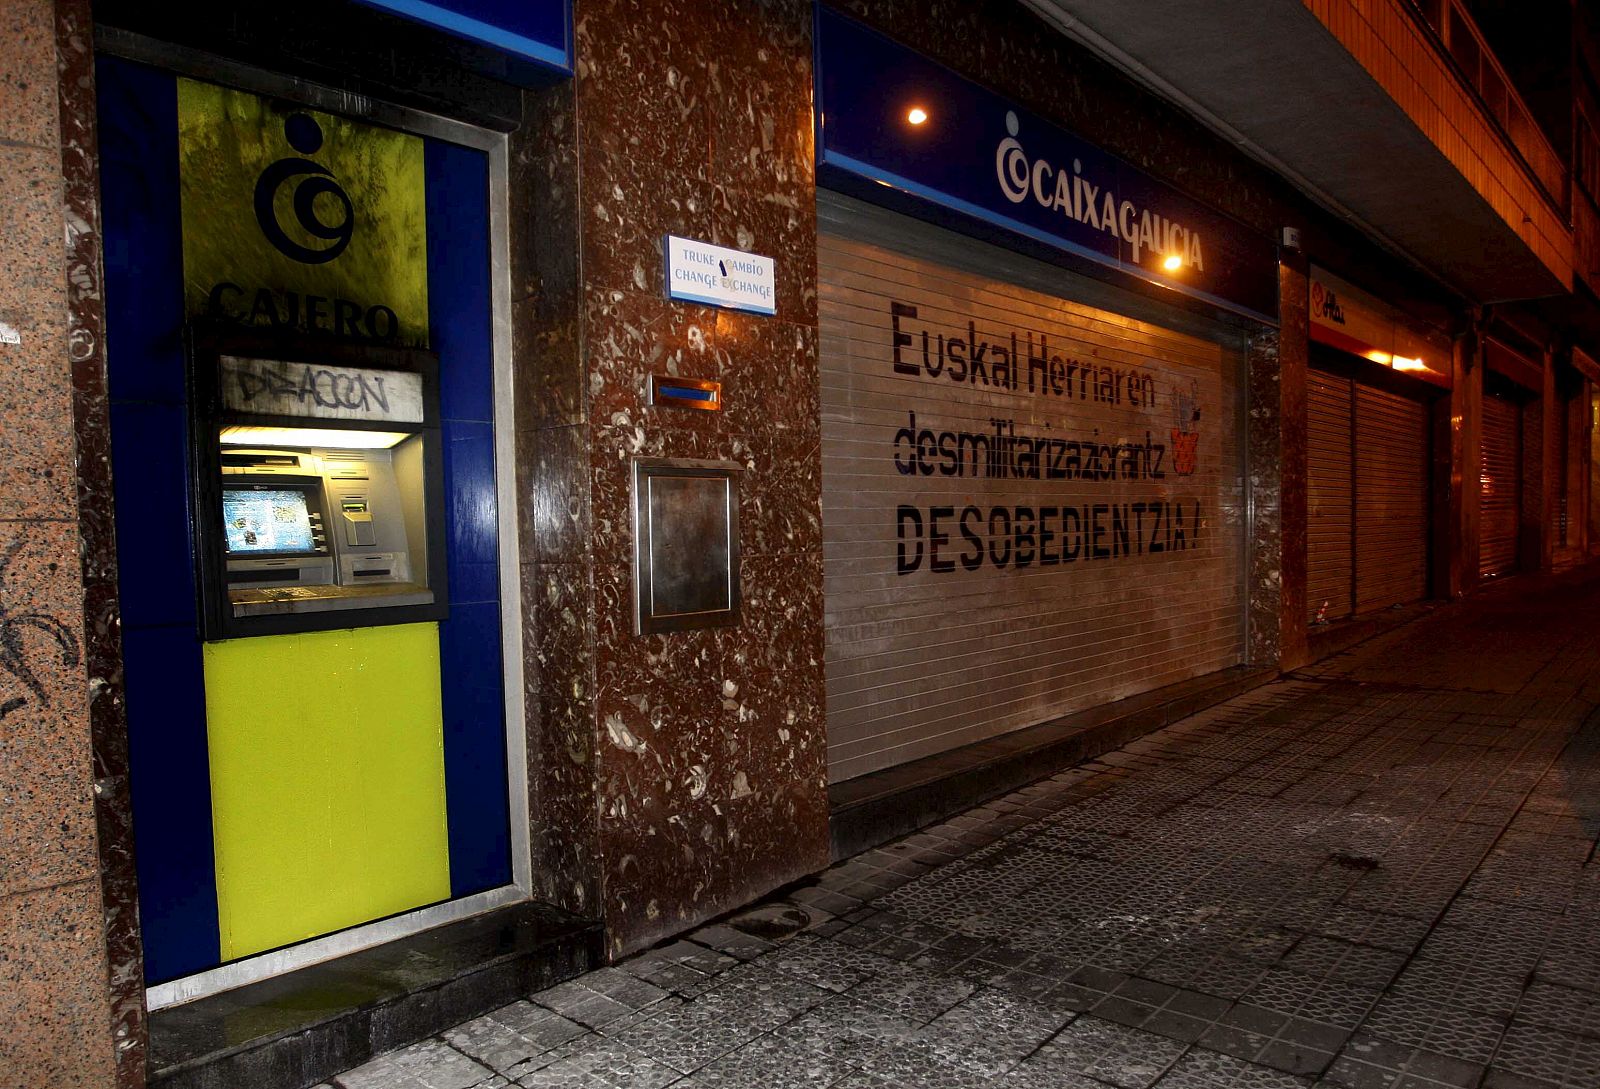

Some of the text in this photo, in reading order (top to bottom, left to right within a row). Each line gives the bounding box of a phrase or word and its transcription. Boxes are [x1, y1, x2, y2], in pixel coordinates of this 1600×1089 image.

[683, 249, 714, 266] TRUKE
[675, 268, 718, 288] CHANGE
[208, 282, 399, 342] CAJERO
[891, 301, 1156, 409] Euskal Herriaren
